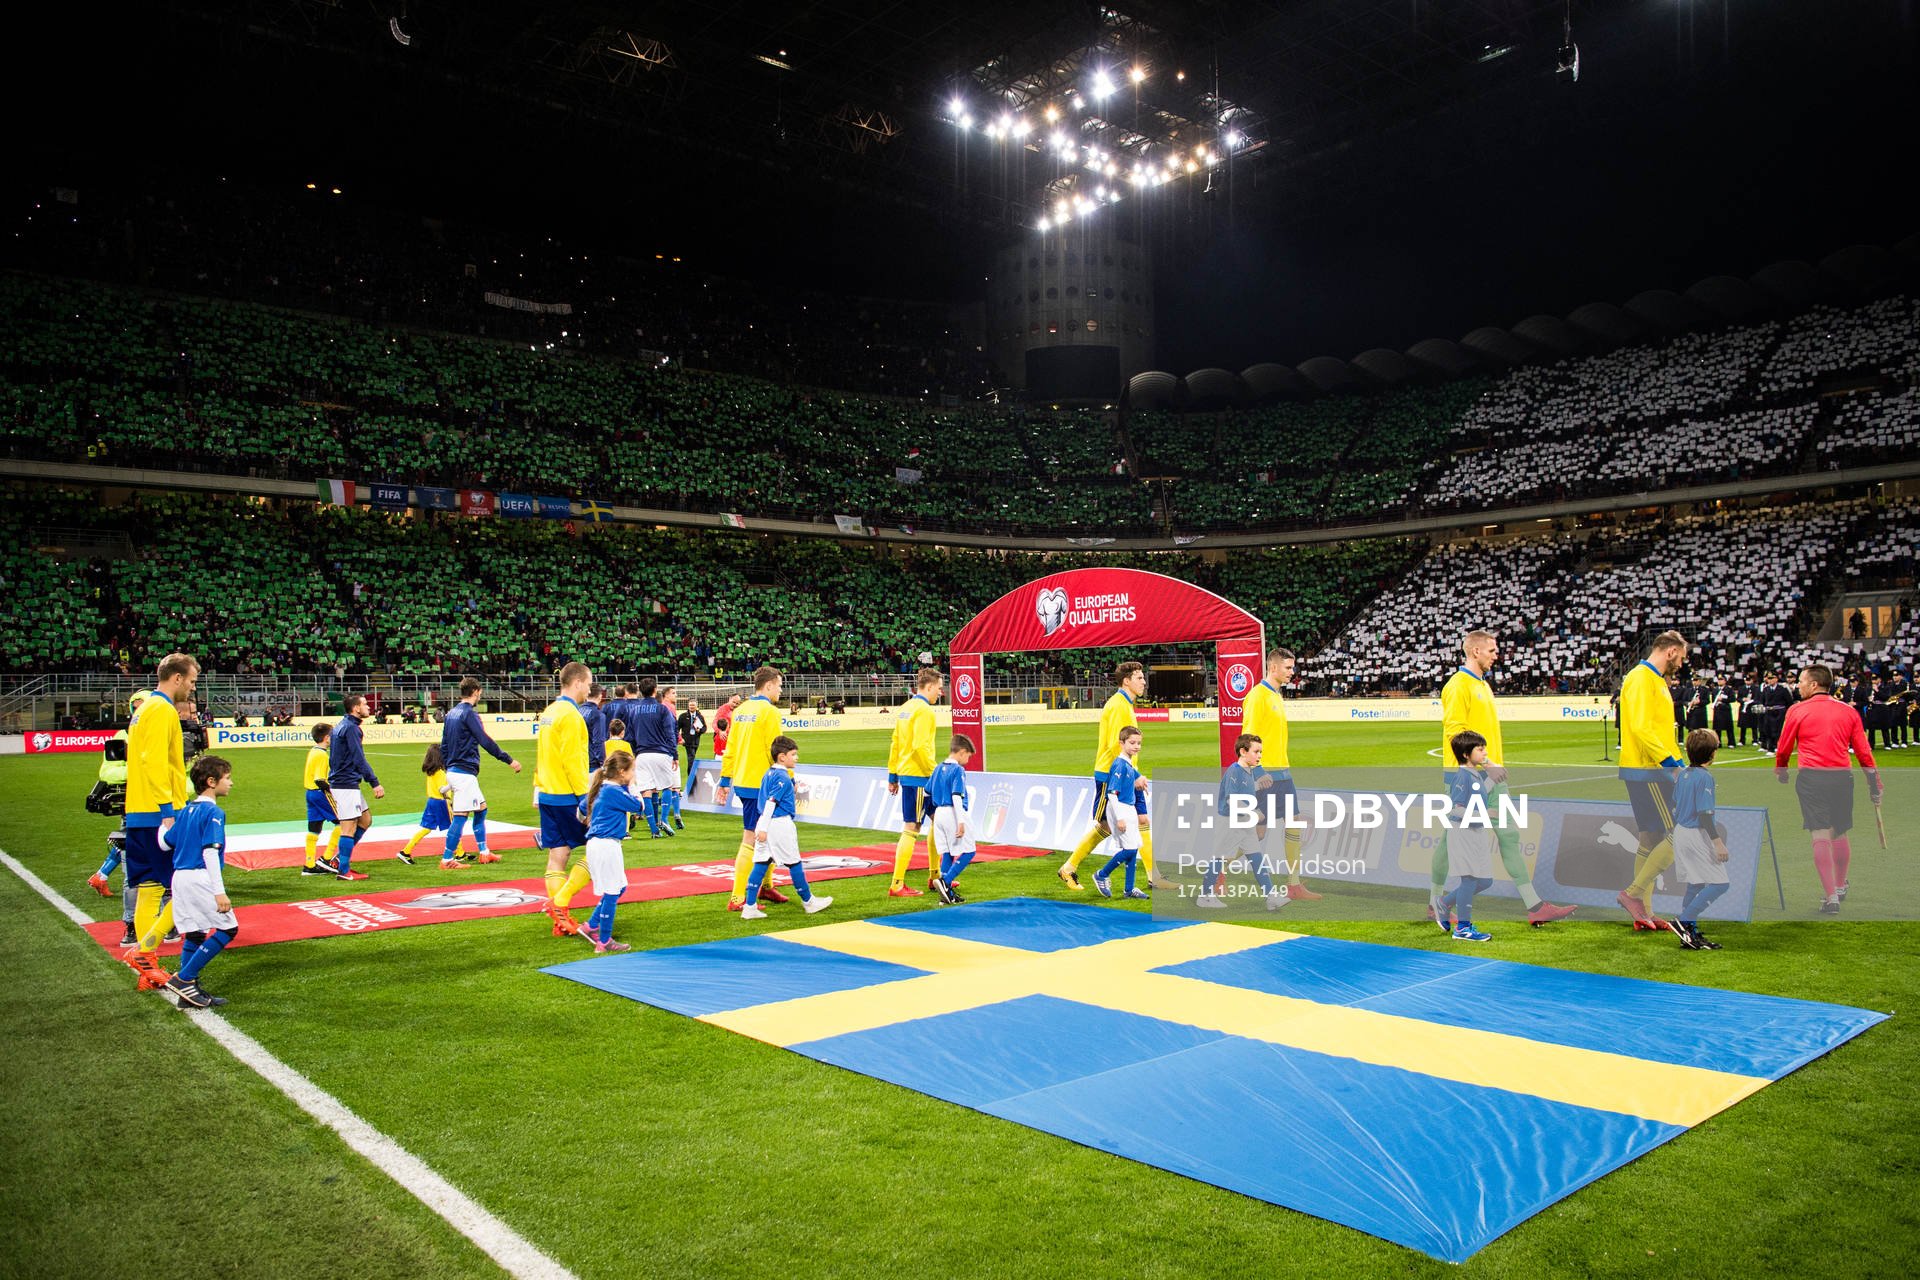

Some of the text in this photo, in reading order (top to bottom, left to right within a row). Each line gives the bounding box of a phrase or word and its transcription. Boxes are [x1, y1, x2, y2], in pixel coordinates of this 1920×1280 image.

[378, 489, 401, 500] FIFA
[502, 500, 532, 511] UEFA
[1074, 593, 1129, 609] EUROPEAN
[1069, 606, 1137, 627] QUALIFIERS
[257, 695, 300, 704] PCENO
[952, 708, 979, 718] RESPECT
[1222, 706, 1243, 717] RESP
